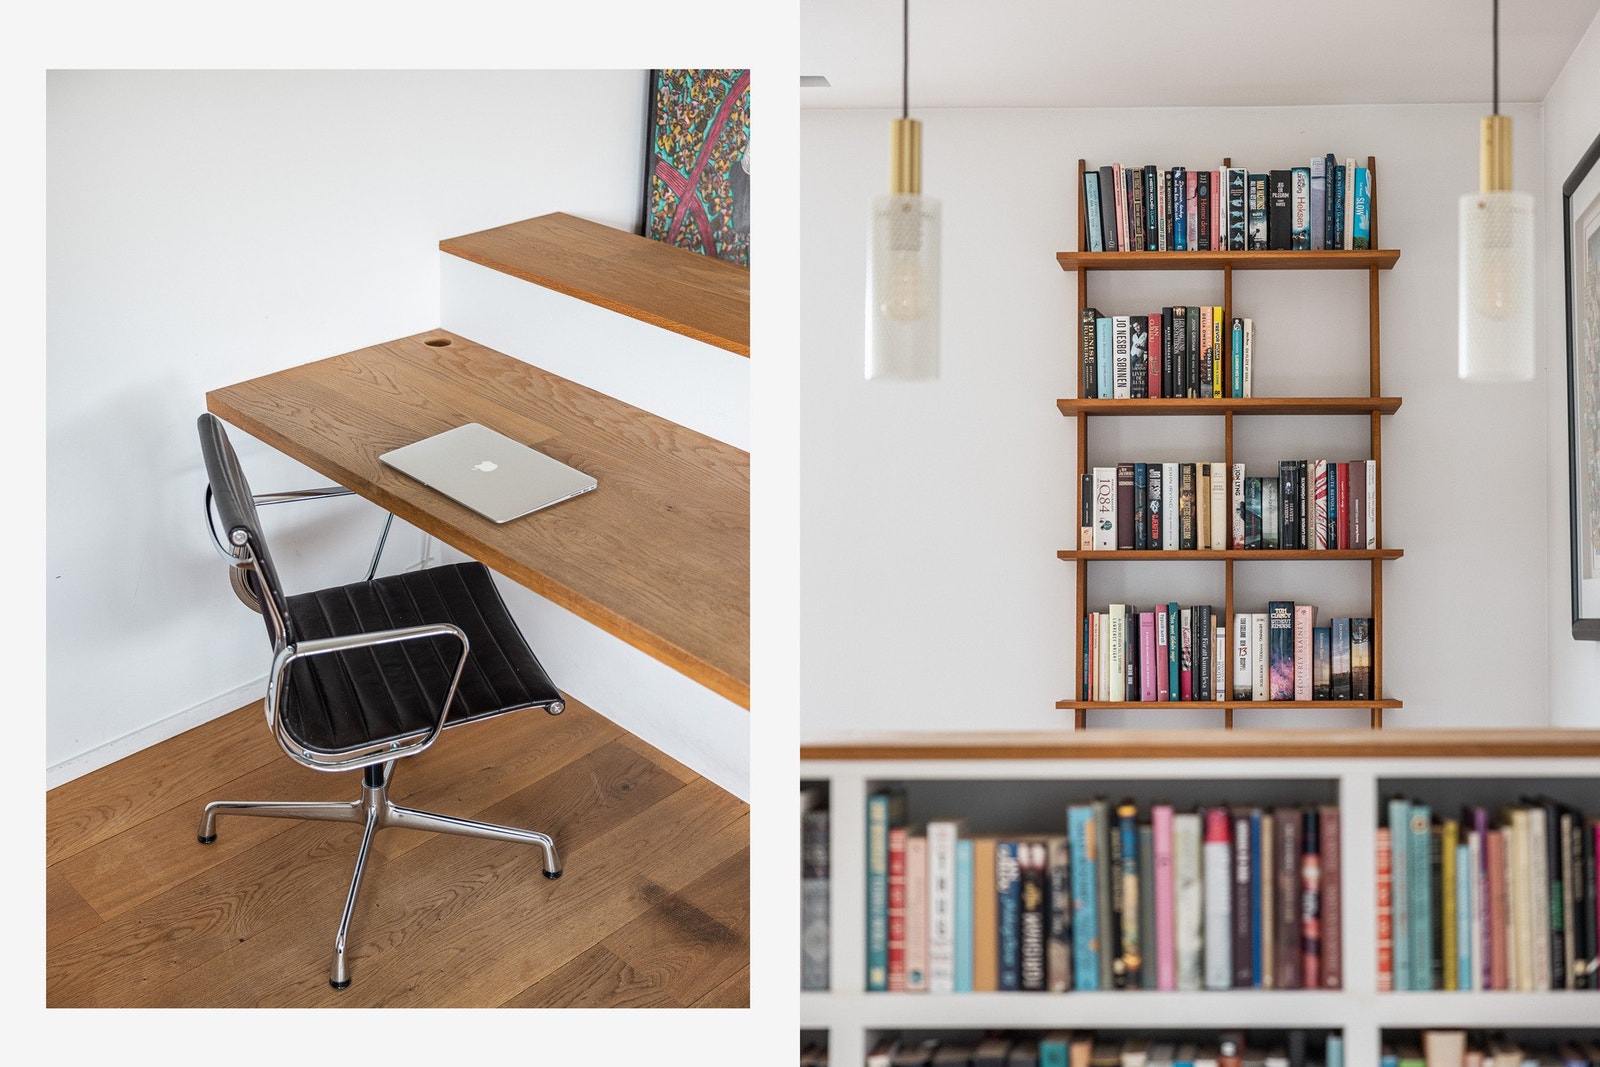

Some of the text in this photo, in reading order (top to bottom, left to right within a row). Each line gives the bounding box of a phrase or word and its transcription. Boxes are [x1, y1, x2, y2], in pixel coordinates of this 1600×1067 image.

[1356, 197, 1365, 216] SLOW
[1117, 319, 1127, 388] JO NESBØ SØNNEN
[1149, 469, 1161, 478] JO
[1097, 480, 1111, 513] 1Q84
